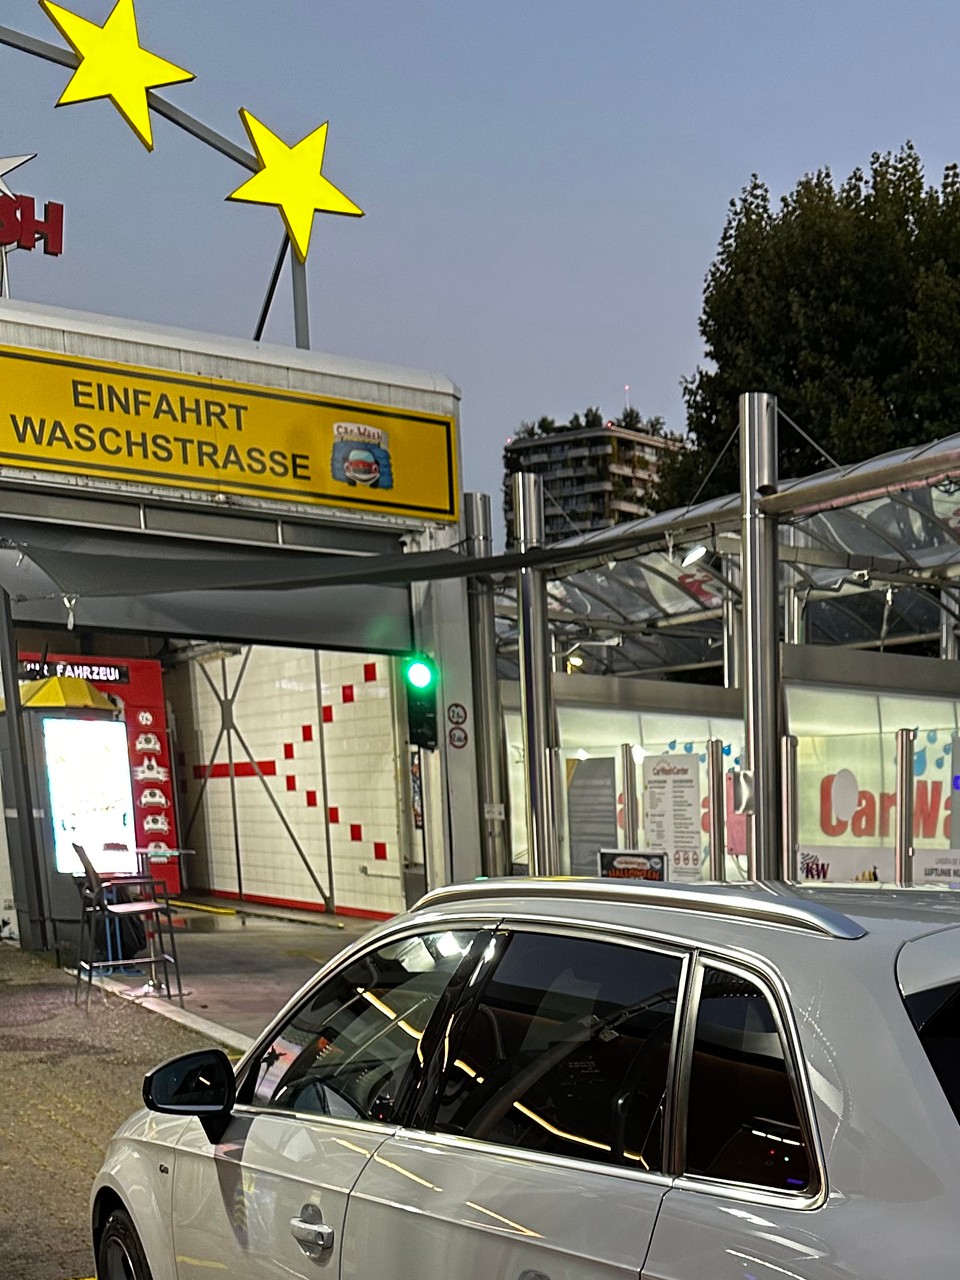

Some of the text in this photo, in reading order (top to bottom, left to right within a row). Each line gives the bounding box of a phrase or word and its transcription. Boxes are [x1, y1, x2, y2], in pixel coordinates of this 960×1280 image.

[71, 378, 249, 432] EINFAHRT
[9, 413, 312, 482] WASCHSTRASSE
[336, 424, 383, 441] Car Wash
